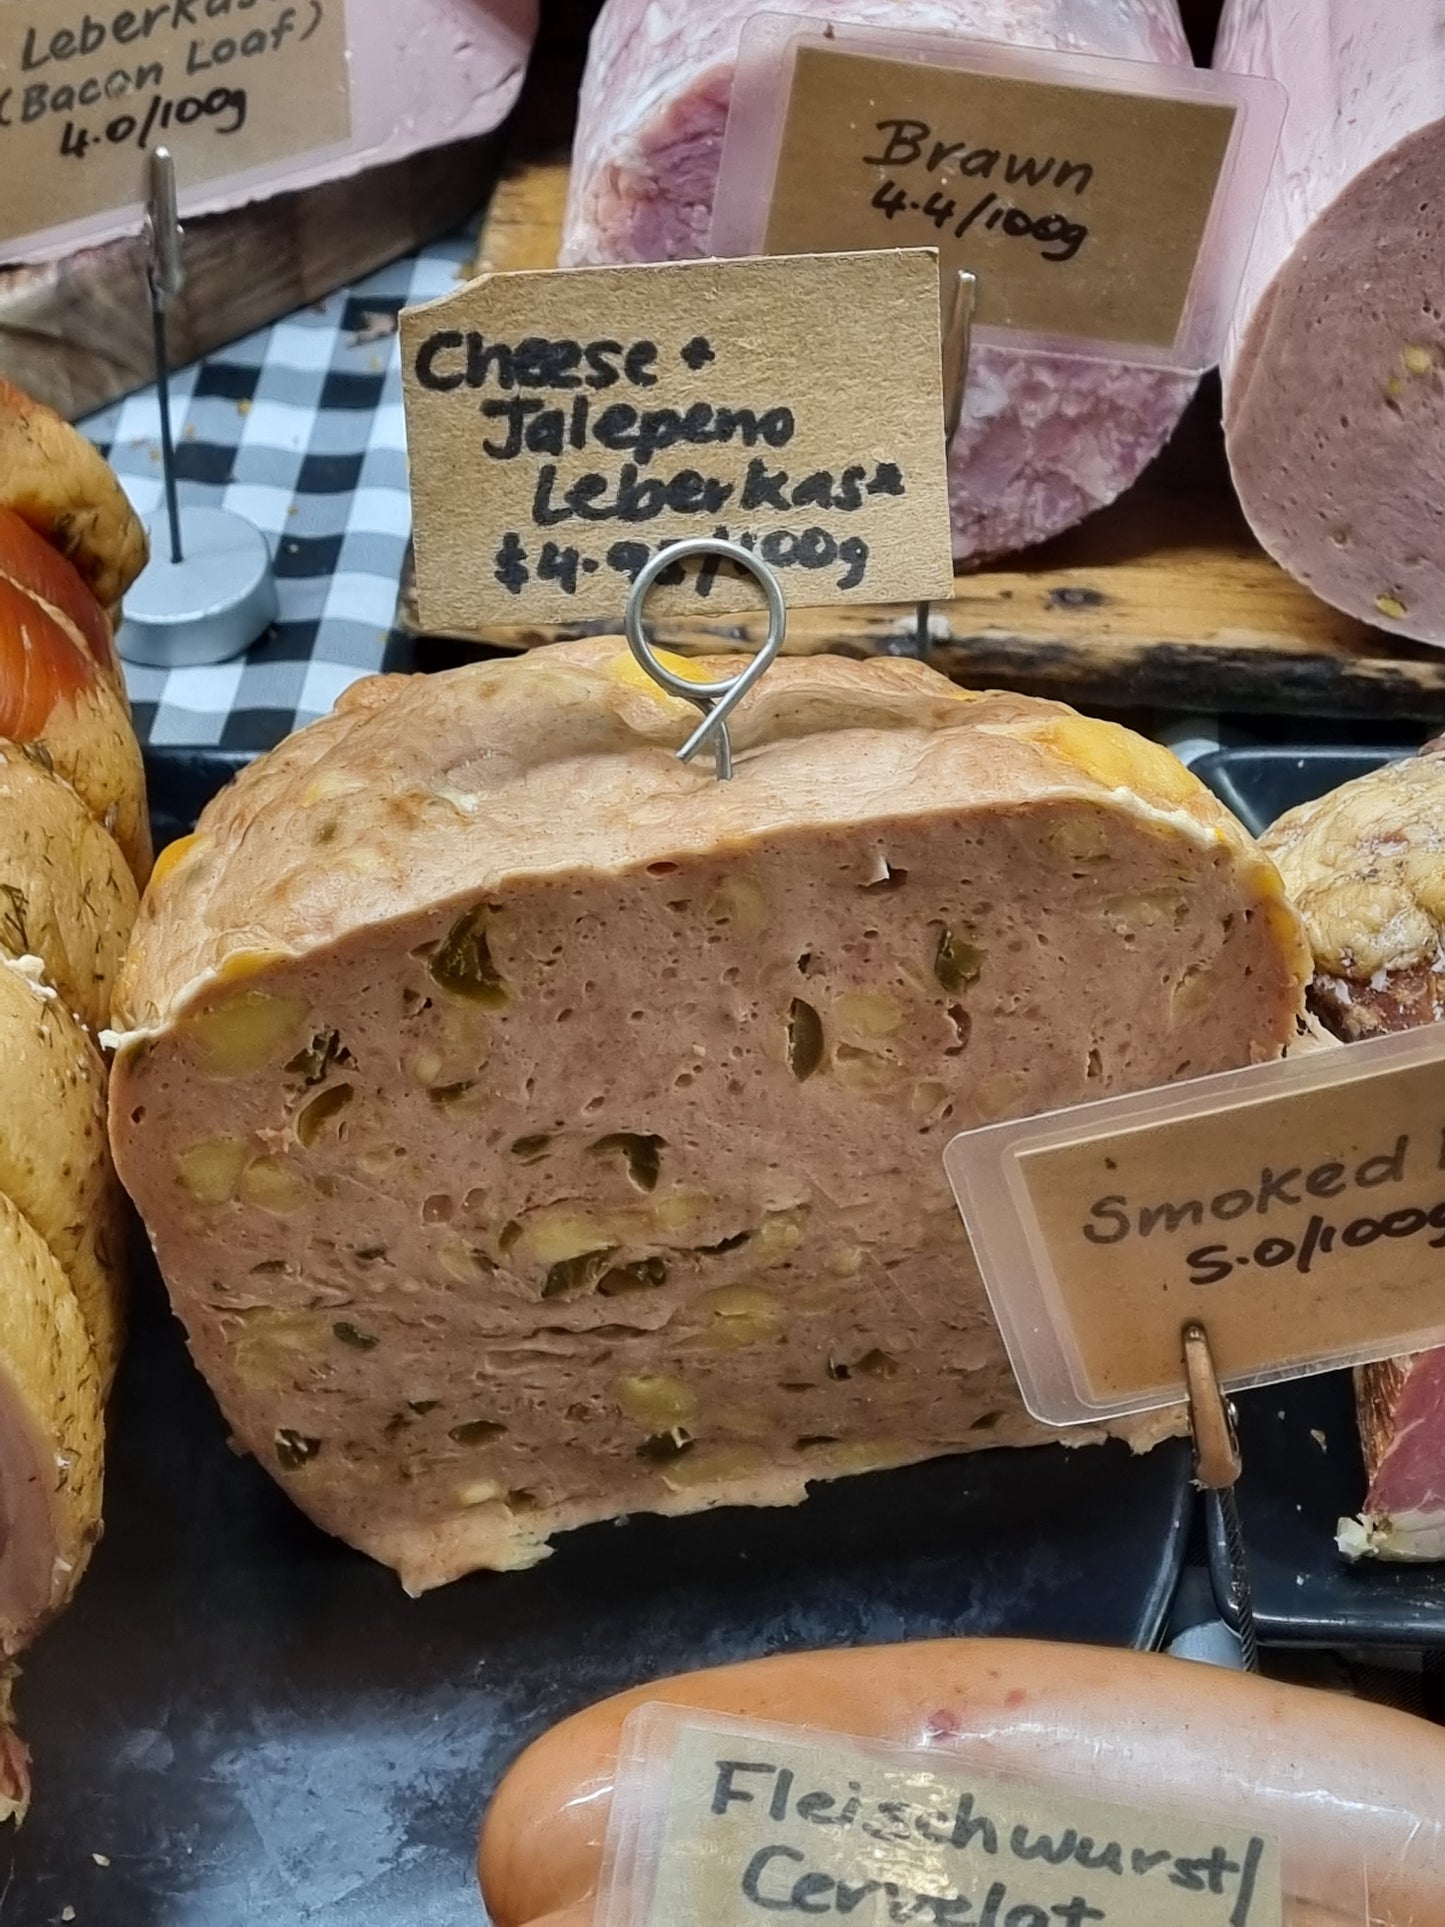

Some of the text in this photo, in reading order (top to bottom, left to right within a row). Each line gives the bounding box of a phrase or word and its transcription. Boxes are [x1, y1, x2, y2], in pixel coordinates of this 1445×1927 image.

[0, 0, 322, 126] (Bacon Loaf)
[21, 0, 279, 71] Leberka
[60, 87, 247, 158] 4.0/100g
[862, 119, 1094, 195] Brawn
[871, 180, 1088, 261] 4.4/100g
[415, 330, 659, 392] Cheese
[1083, 1133, 1409, 1244] Smoked
[710, 1760, 1264, 1926] Fleischwurst/
